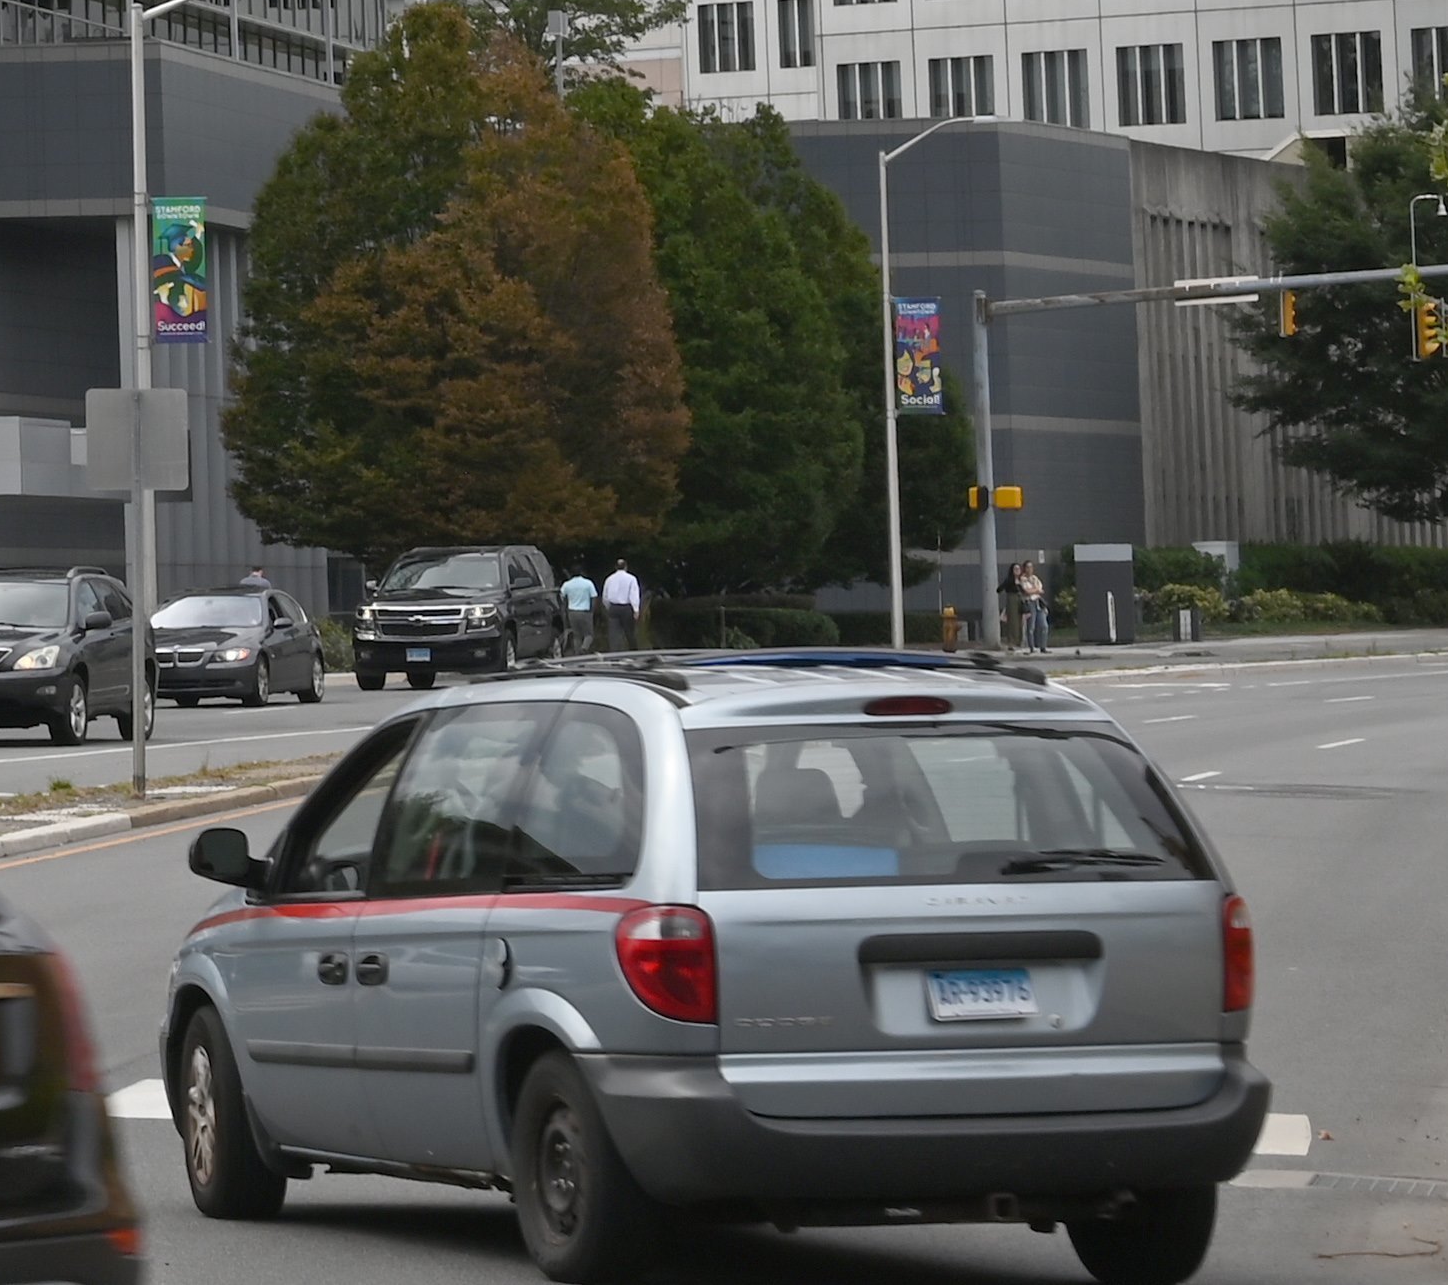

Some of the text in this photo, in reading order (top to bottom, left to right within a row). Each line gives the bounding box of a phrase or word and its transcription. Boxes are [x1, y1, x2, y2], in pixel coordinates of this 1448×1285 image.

[155, 204, 201, 214] STAMFORD
[898, 302, 936, 310] STAMFORD
[157, 320, 206, 332] Succeed!
[900, 394, 940, 406] Social!
